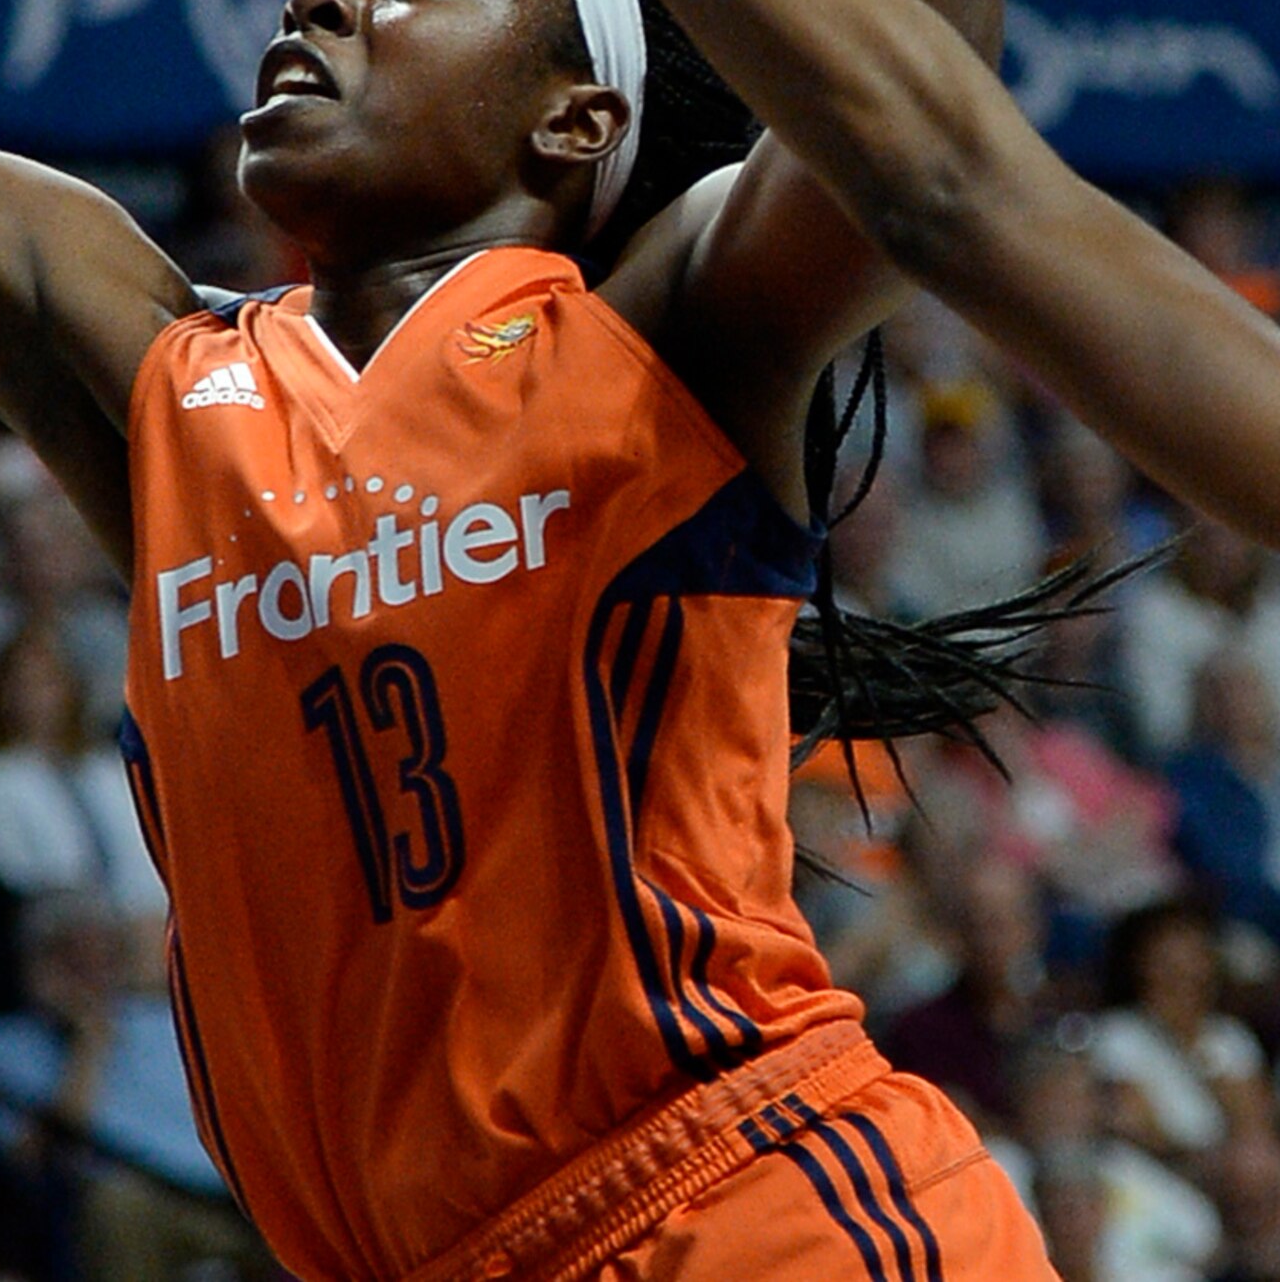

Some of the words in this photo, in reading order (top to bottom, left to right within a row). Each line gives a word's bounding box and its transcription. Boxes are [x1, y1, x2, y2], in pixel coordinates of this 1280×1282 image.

[181, 389, 265, 410] adidas
[157, 489, 571, 681] Frontier
[299, 642, 466, 925] 13
